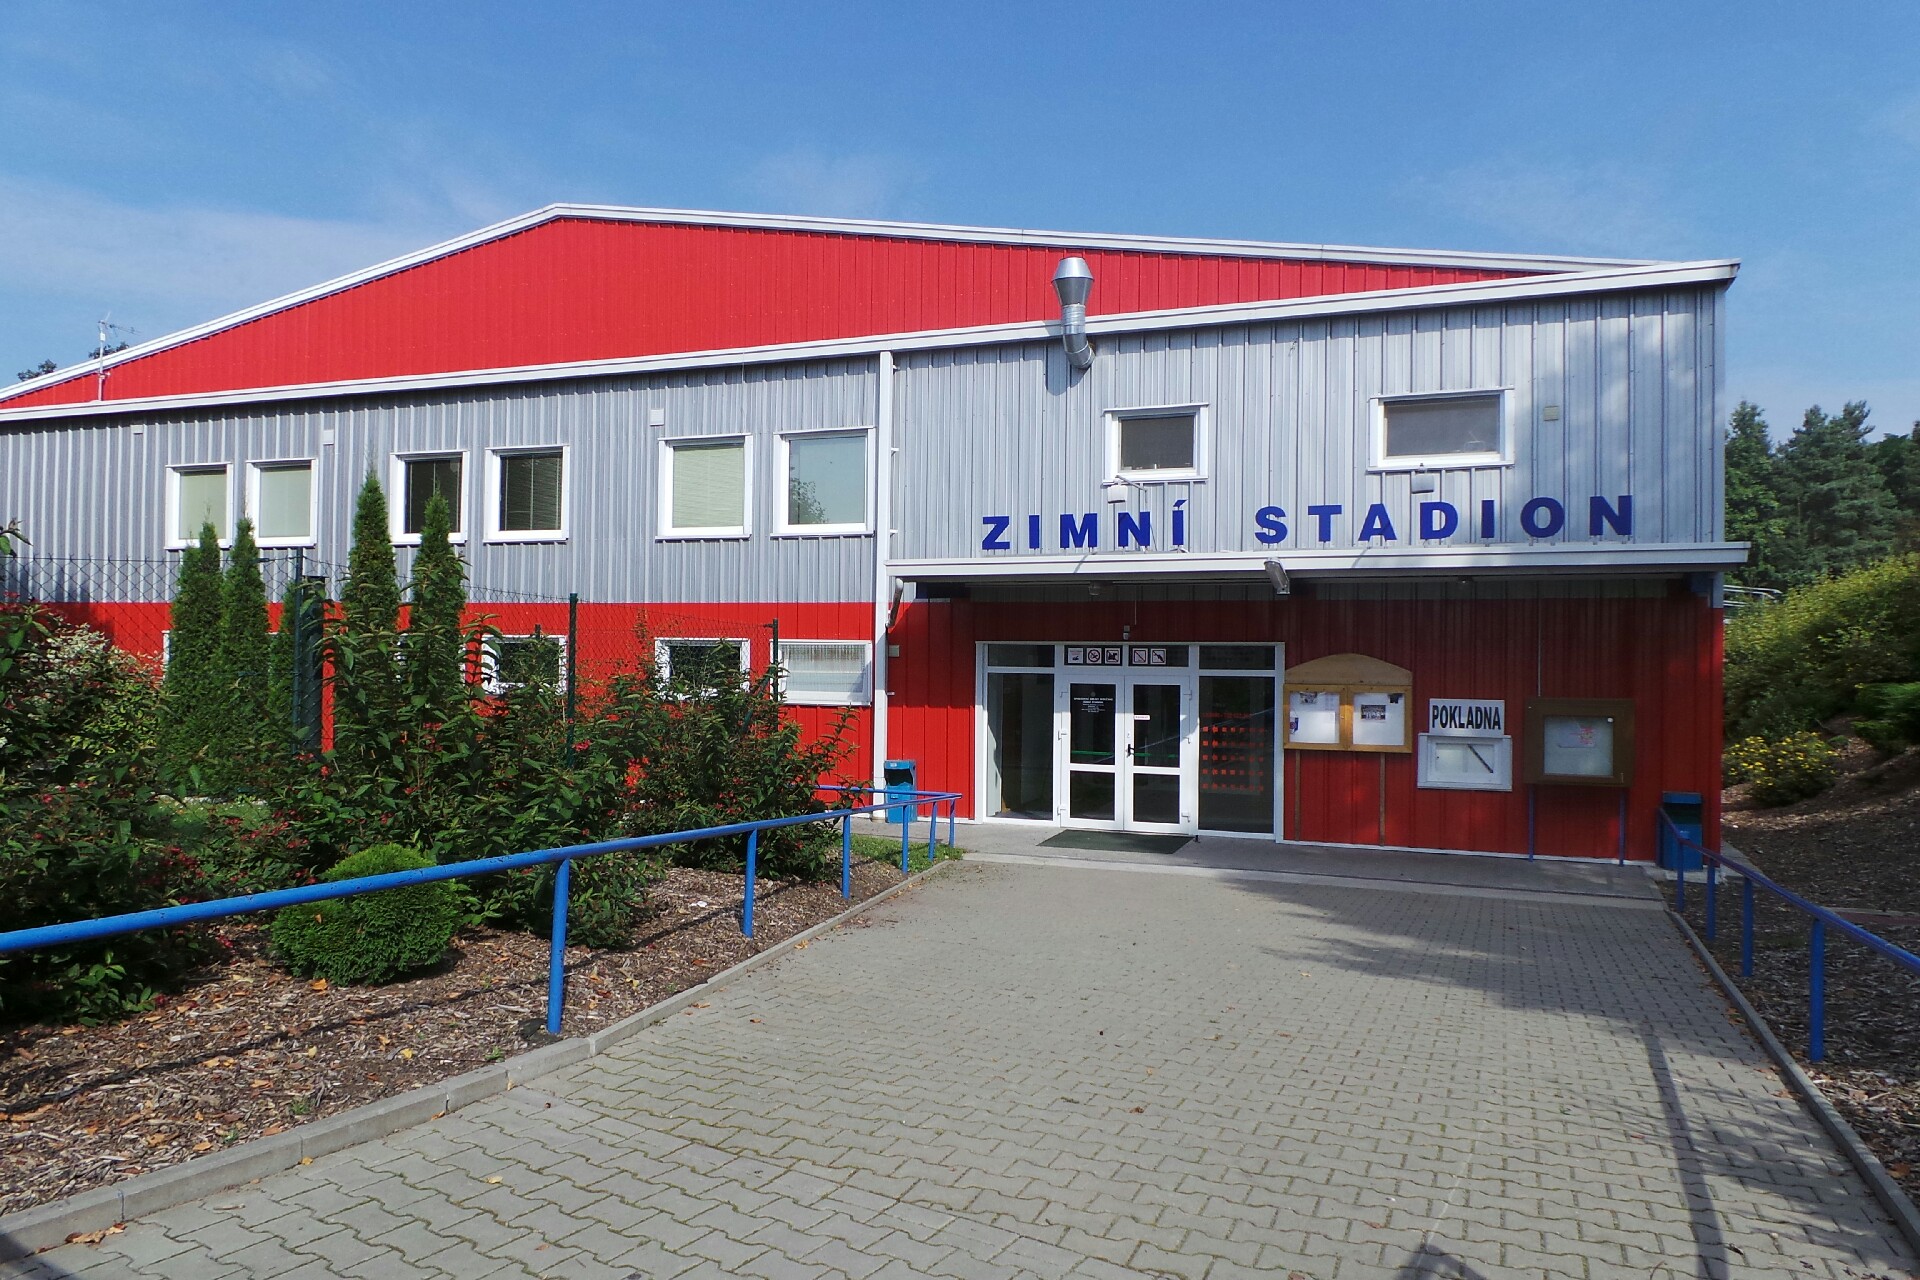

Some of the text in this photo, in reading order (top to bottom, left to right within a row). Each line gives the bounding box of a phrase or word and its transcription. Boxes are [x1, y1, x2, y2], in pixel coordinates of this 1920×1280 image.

[982, 495, 1632, 549] ZIMNÍ STADION
[1432, 705, 1501, 730] POKLADNA
